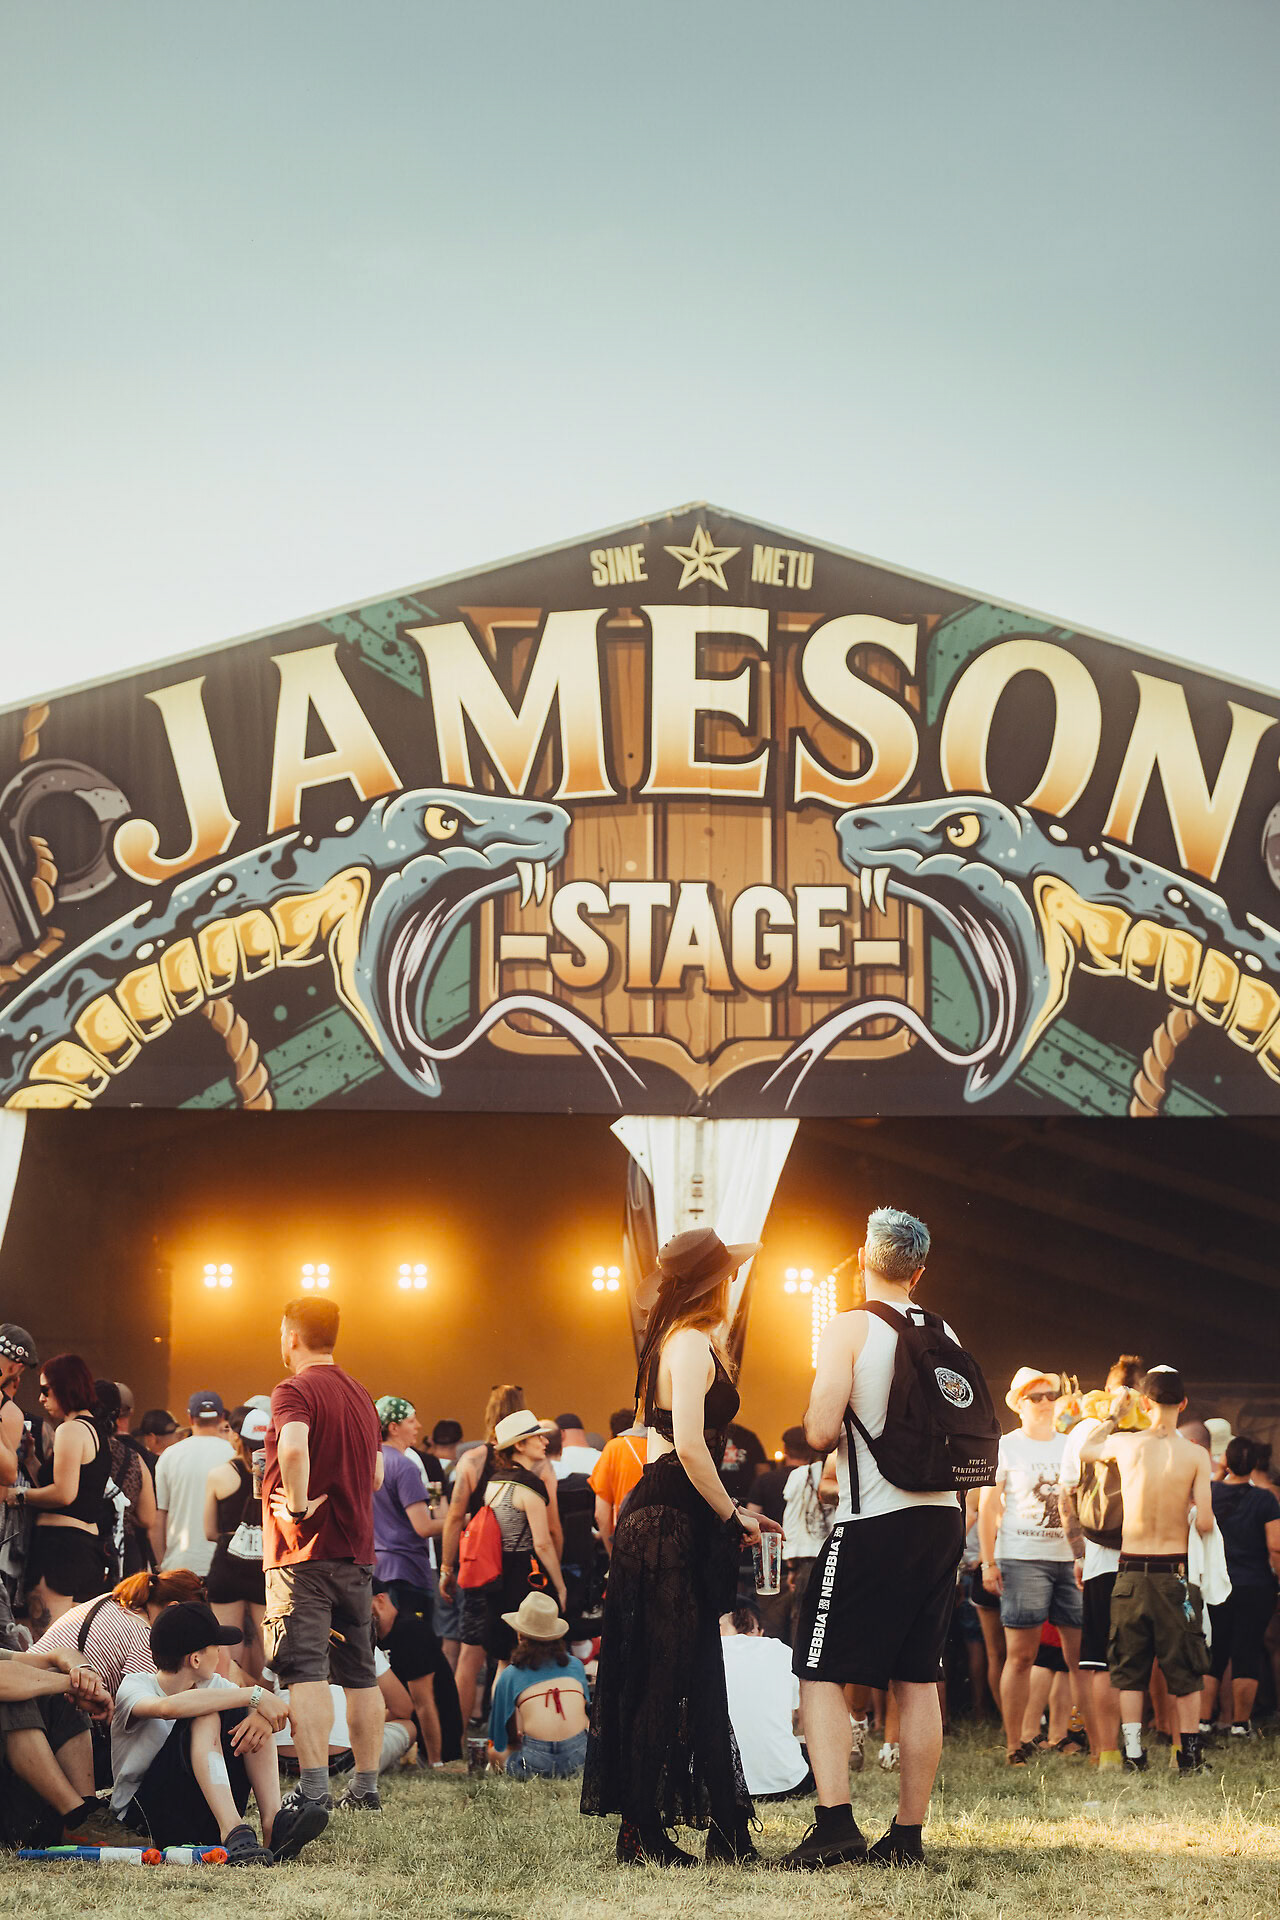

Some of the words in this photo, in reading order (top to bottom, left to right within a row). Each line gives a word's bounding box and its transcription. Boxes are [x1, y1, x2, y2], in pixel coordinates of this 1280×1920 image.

[590, 543, 648, 586] SINE
[751, 545, 814, 590] METU
[113, 604, 1279, 884] JAMESON
[821, 1540, 841, 1597] NEBBIA
[806, 1612, 828, 1668] NEBBIA
